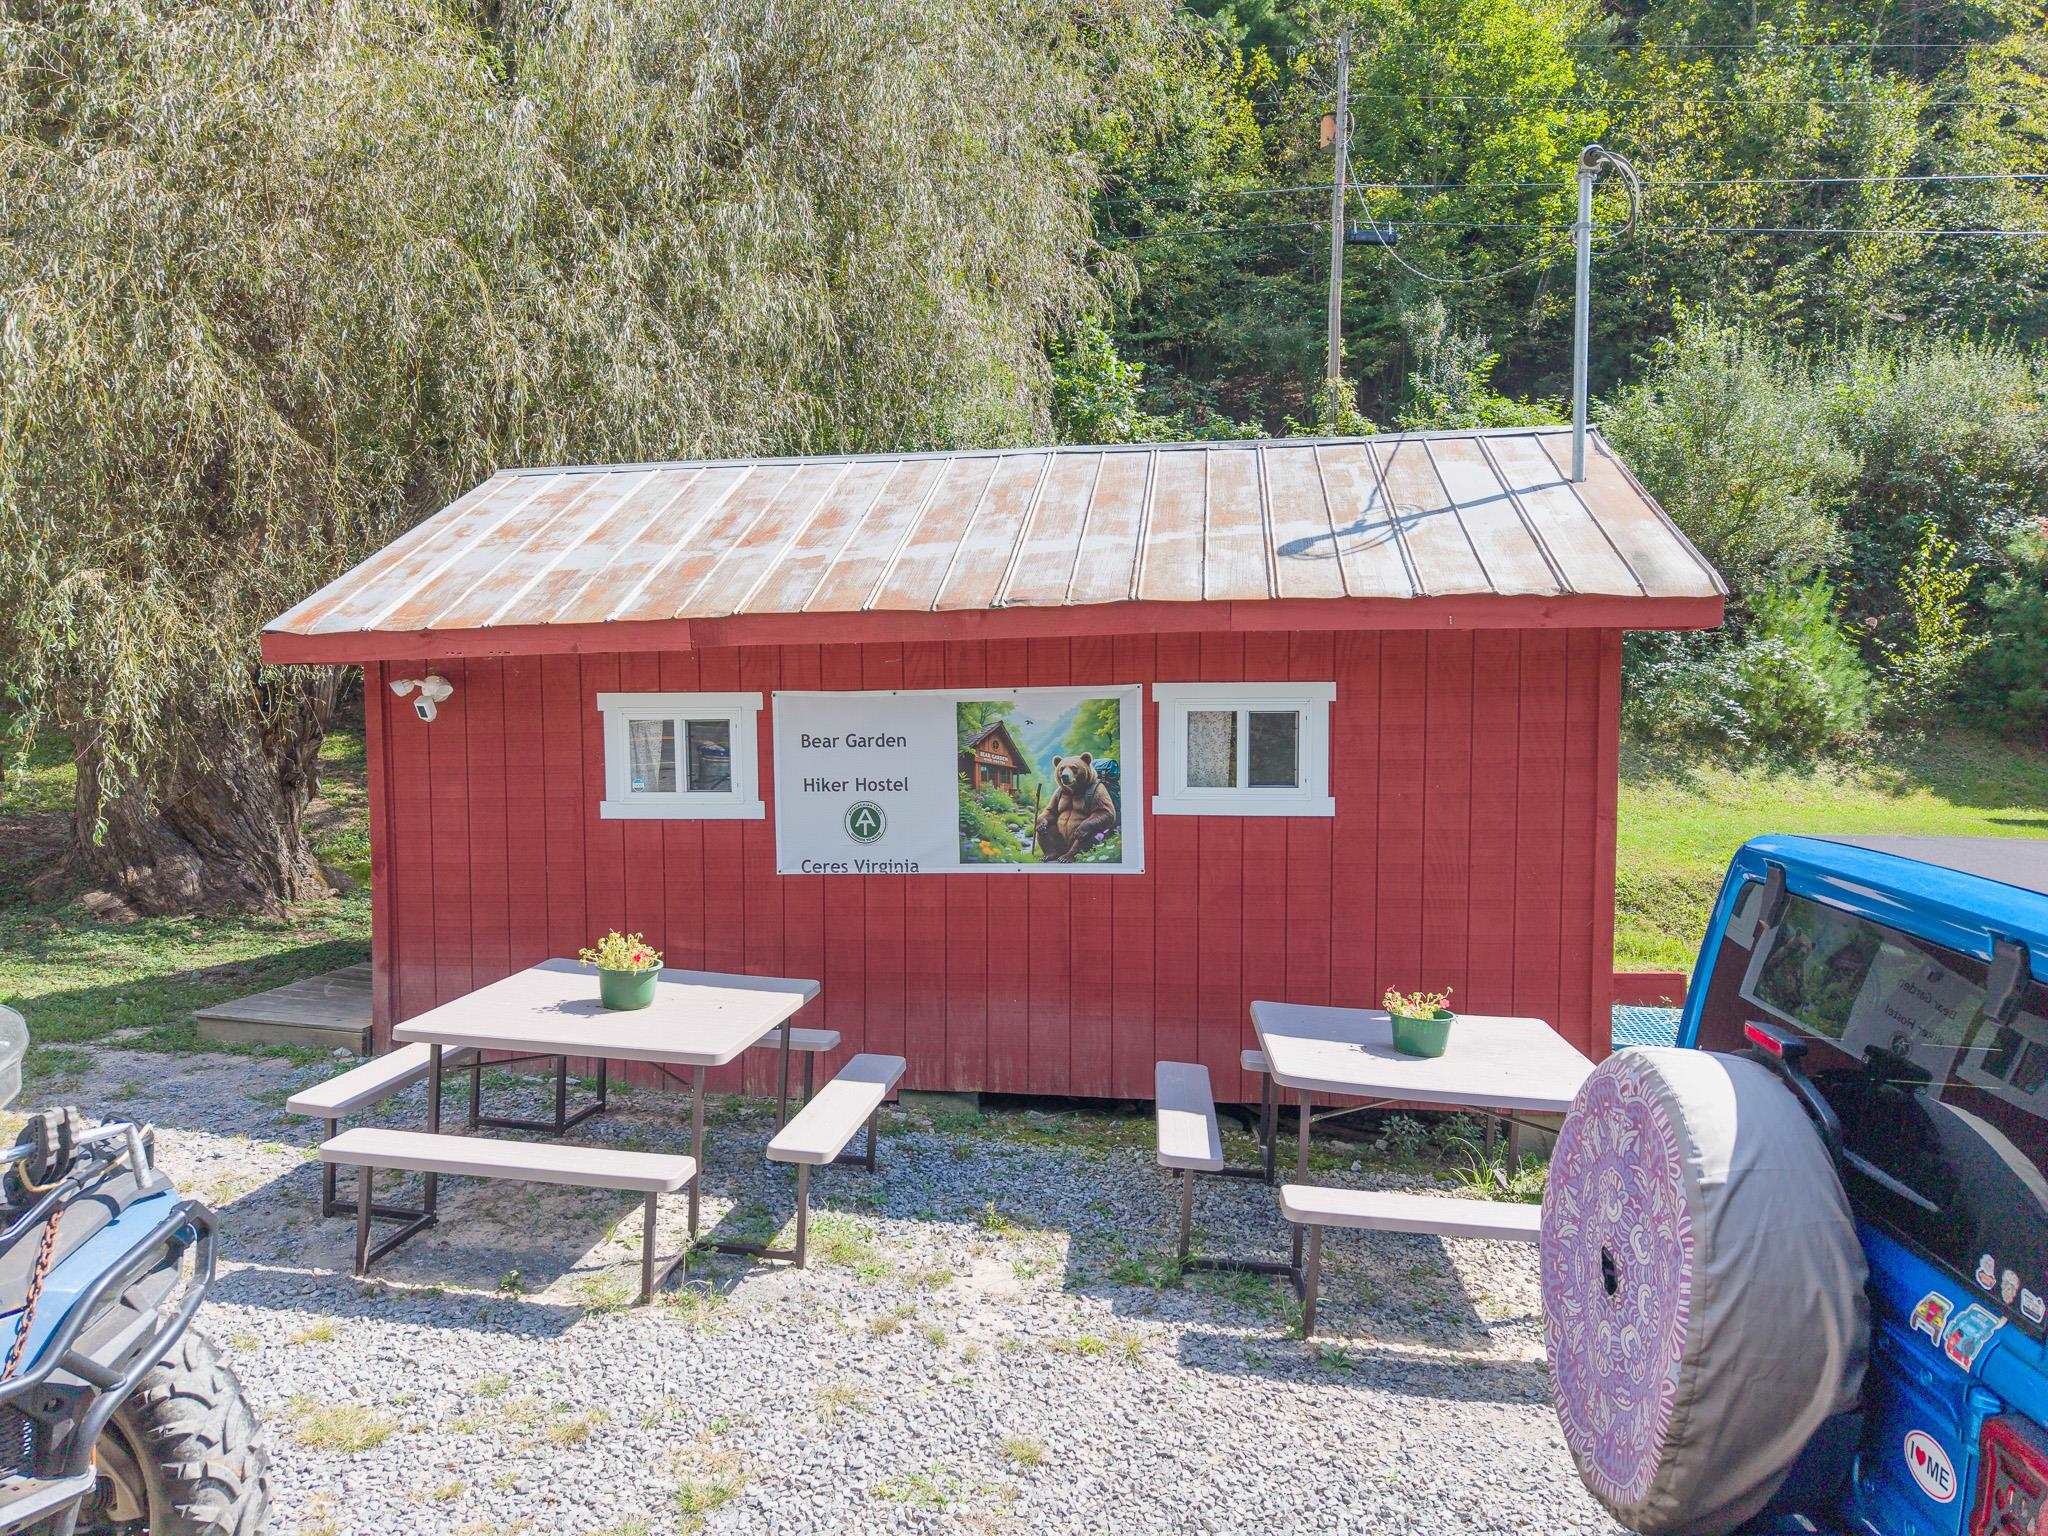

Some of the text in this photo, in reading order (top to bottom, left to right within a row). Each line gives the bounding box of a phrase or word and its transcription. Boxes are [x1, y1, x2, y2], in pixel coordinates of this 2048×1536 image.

[801, 732, 907, 748] Bear Garden
[803, 776, 909, 792] Hiker Hostel
[801, 859, 920, 875] Ceres Virginia
[1910, 1440, 1950, 1492] I ME
